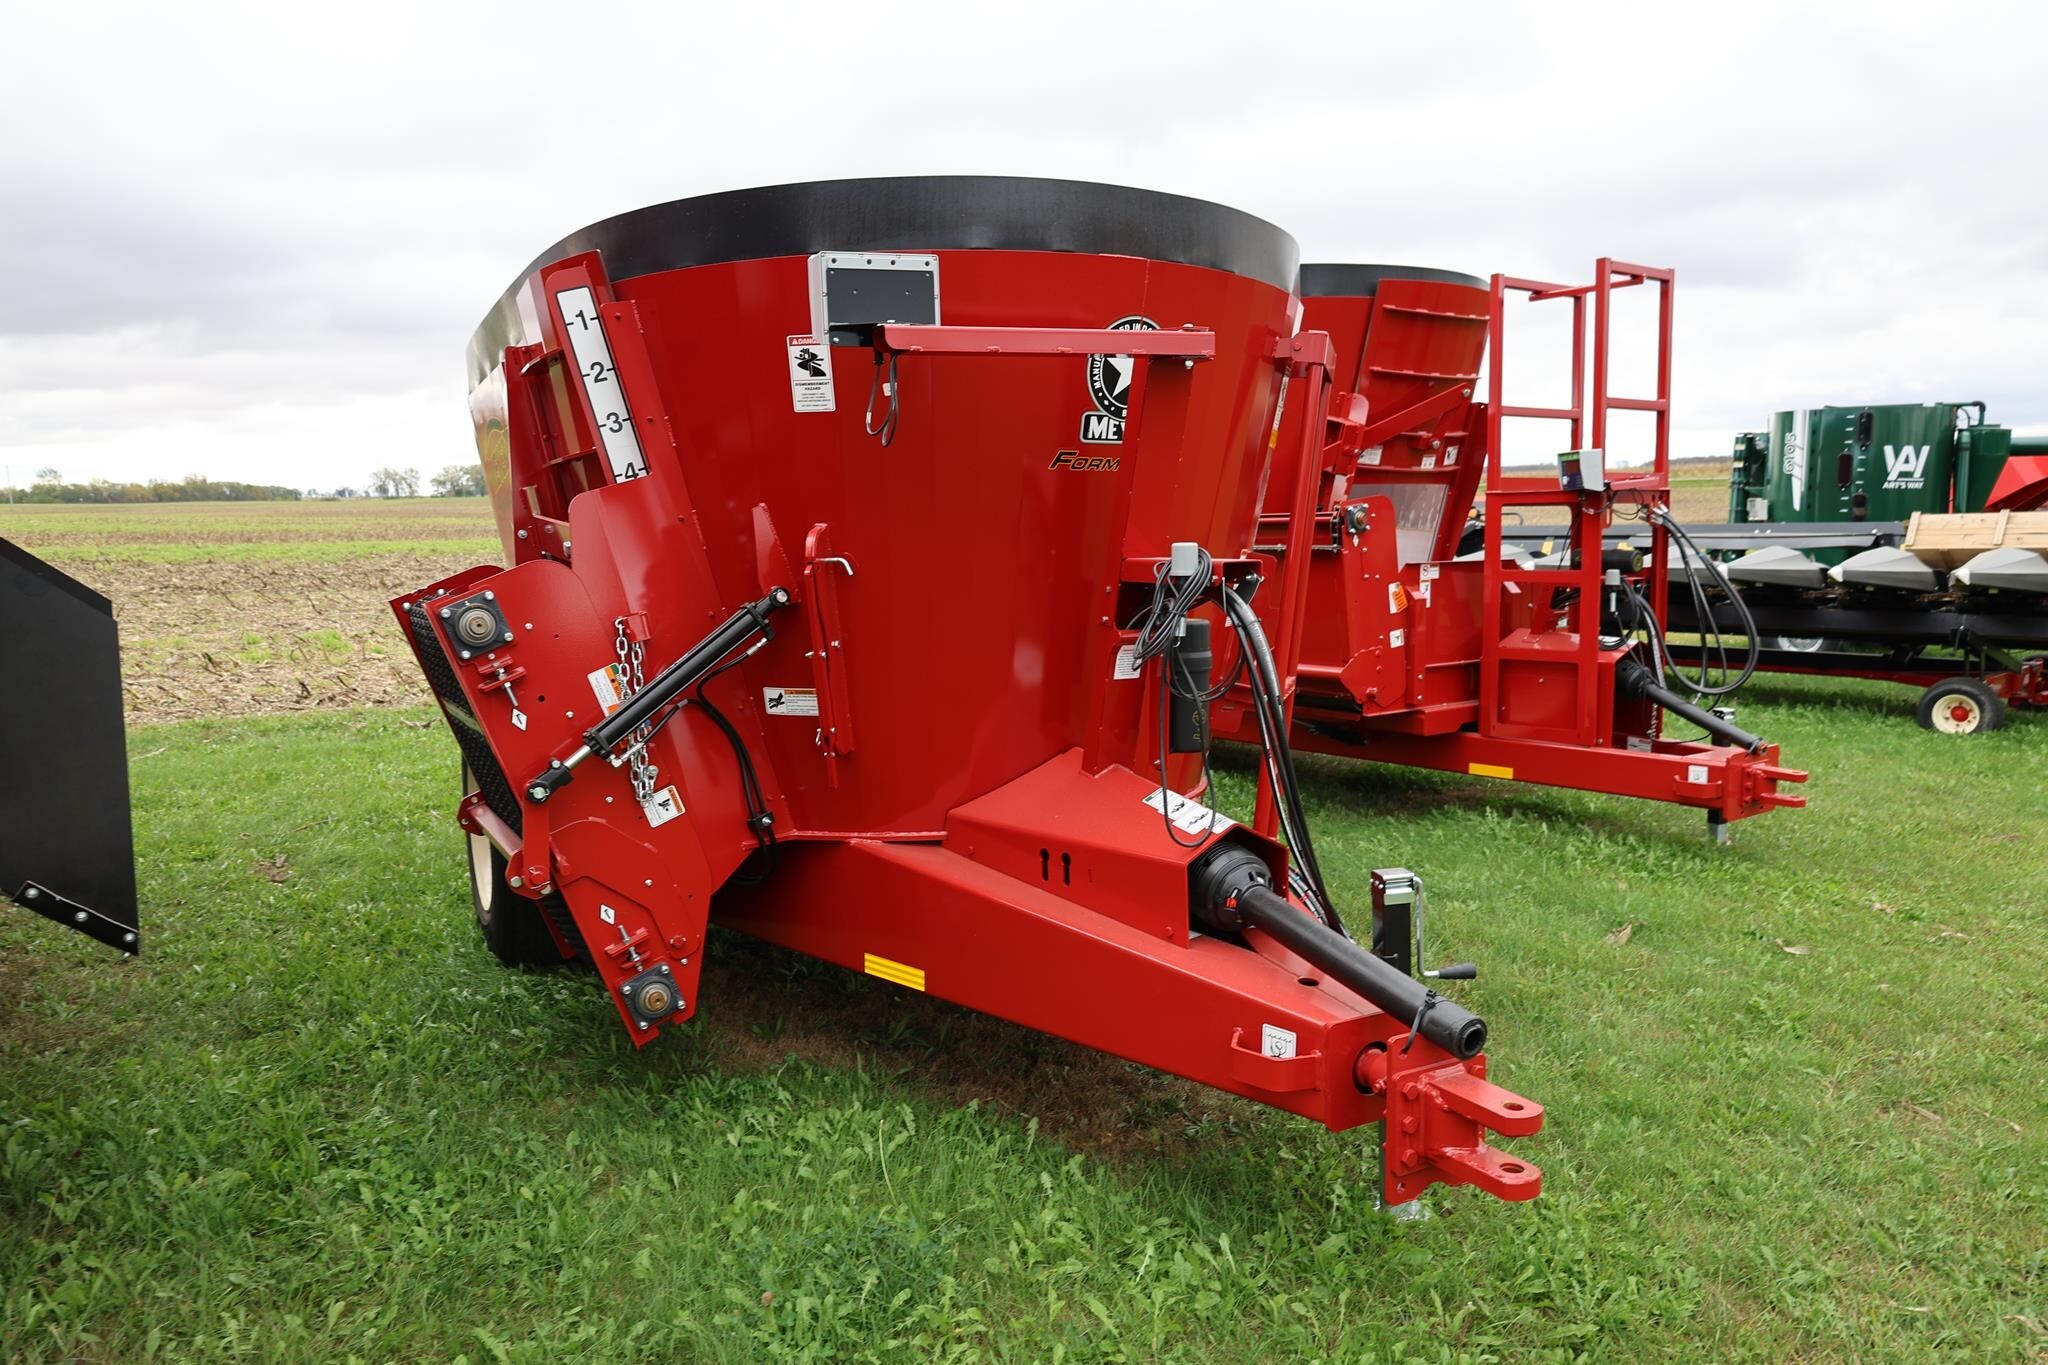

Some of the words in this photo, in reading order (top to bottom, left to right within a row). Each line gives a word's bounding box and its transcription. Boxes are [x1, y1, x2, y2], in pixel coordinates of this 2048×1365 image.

[574, 309, 589, 331] 1
[589, 361, 608, 384] 2
[605, 411, 624, 434] 3
[624, 461, 640, 480] 4
[1907, 481, 1925, 490] WAY
